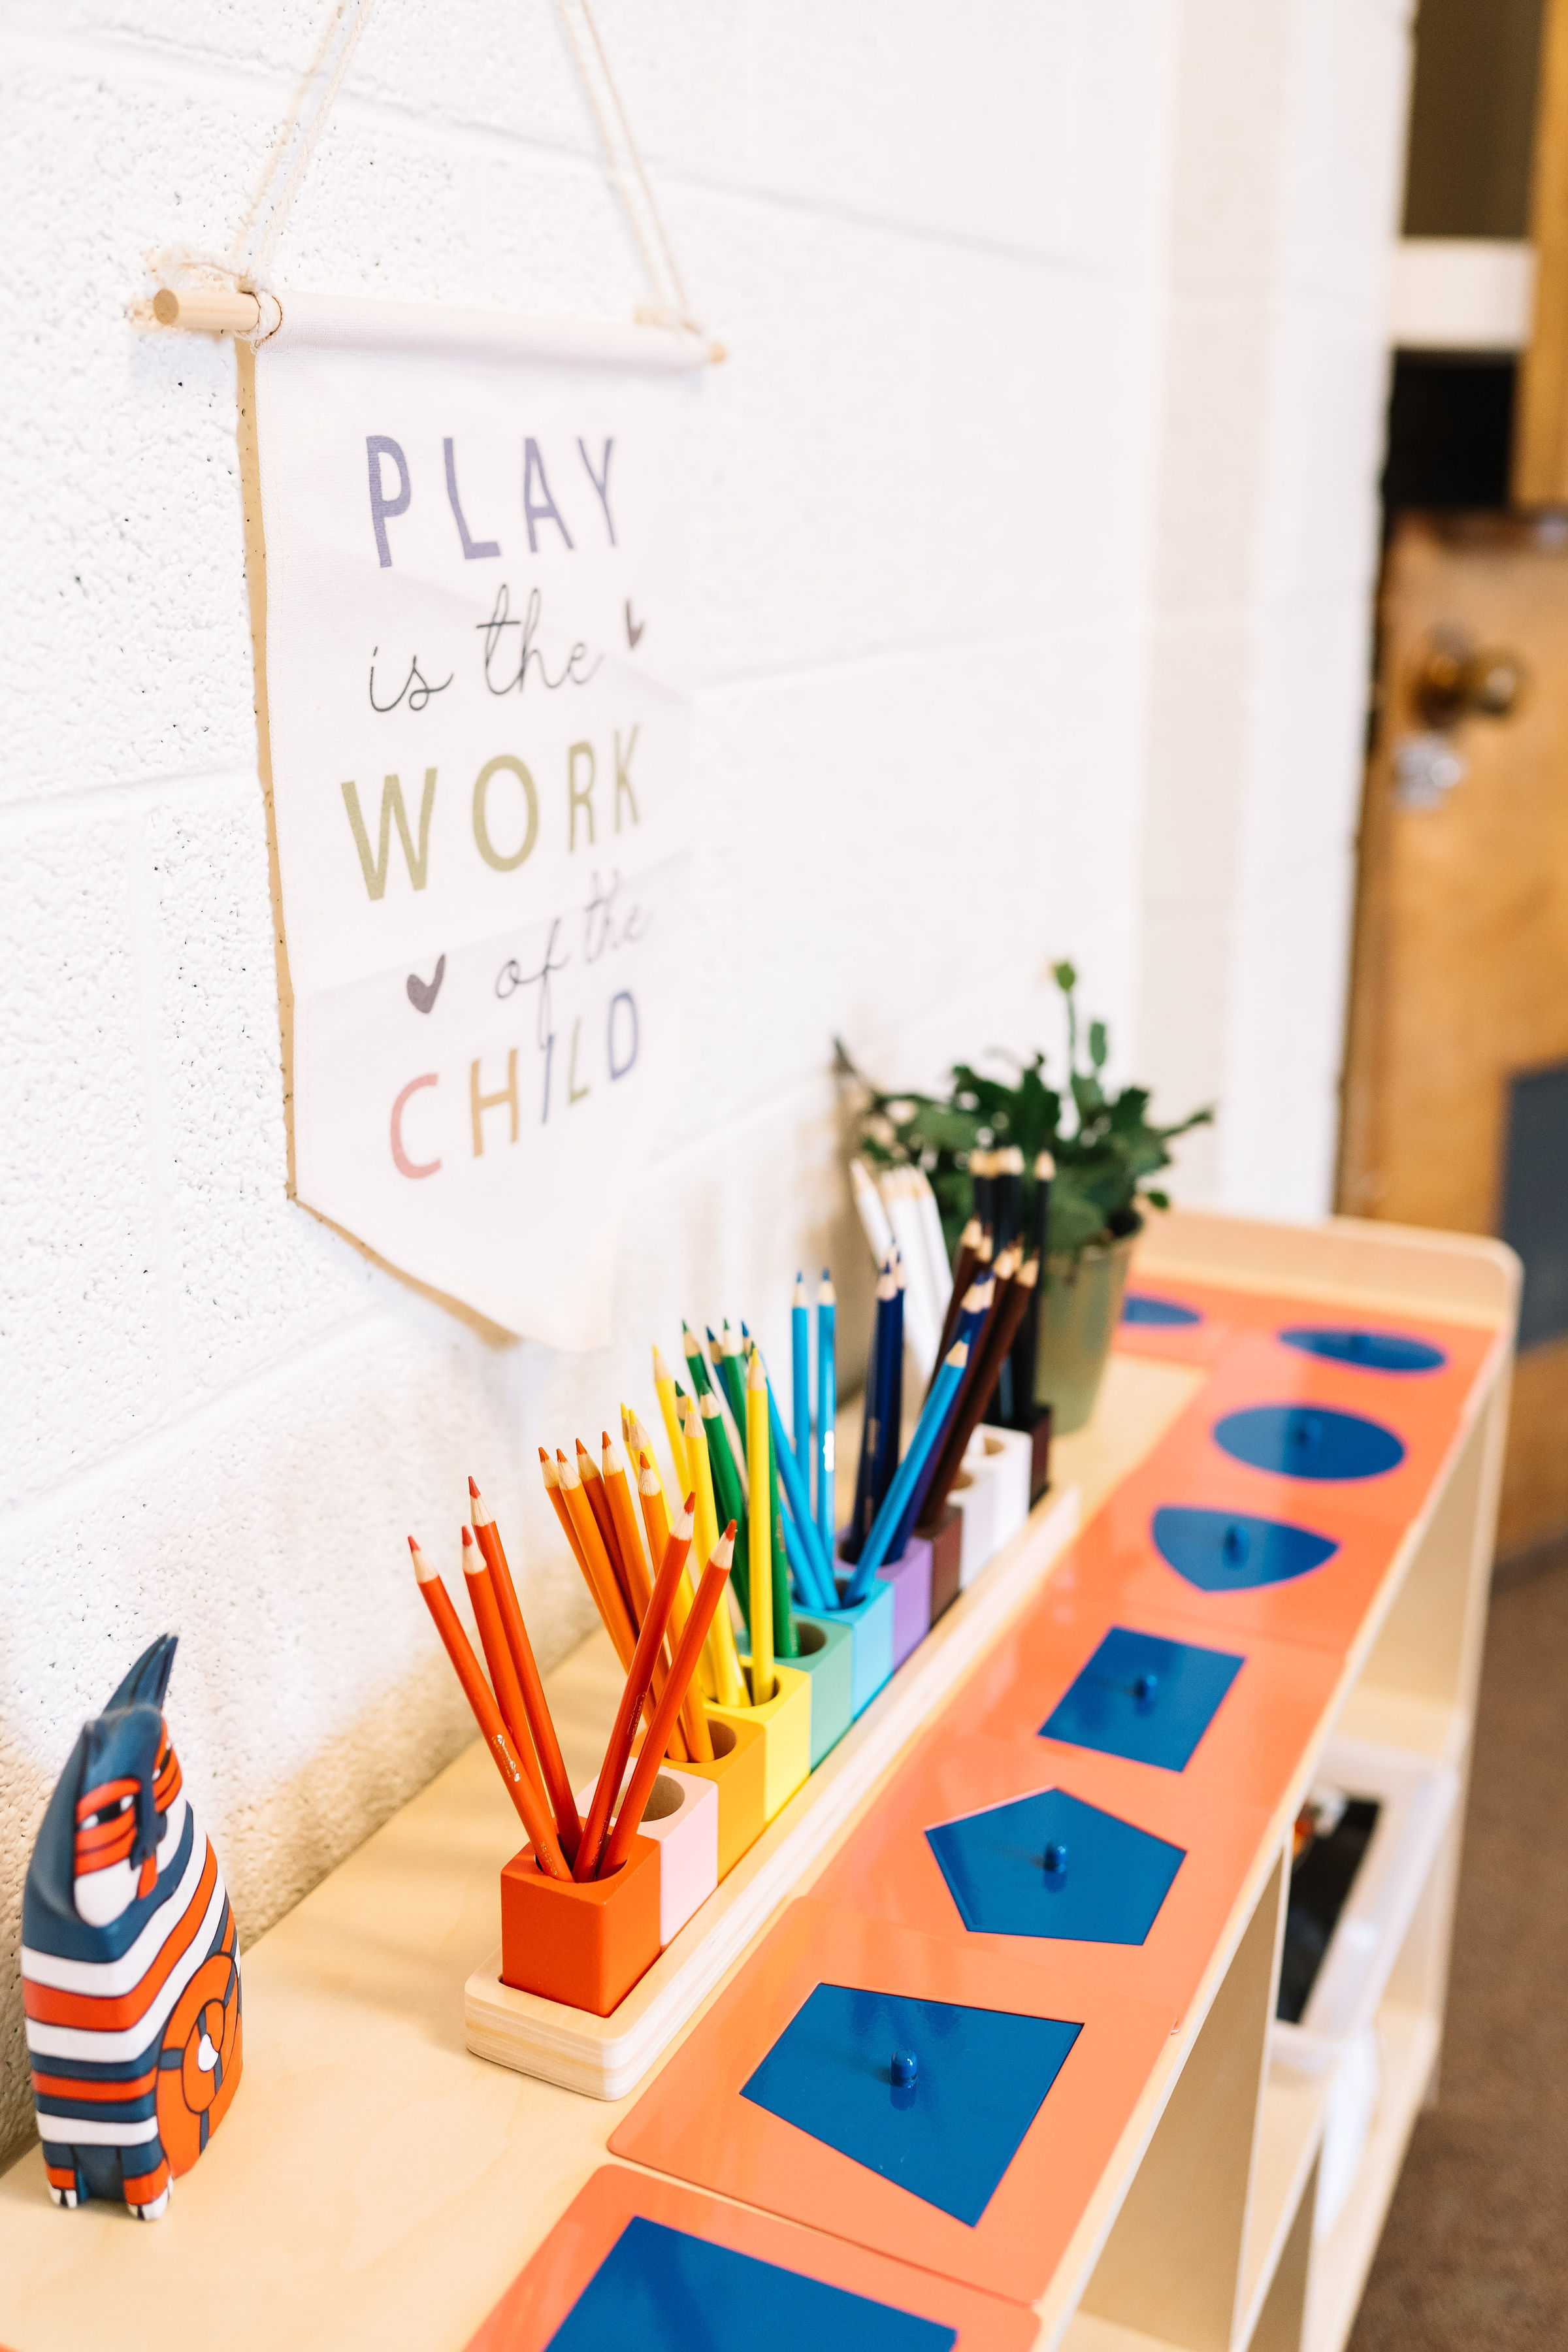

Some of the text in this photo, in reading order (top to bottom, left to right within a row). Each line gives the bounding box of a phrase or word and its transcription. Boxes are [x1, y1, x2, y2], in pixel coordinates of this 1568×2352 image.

[365, 434, 615, 568] PLAY
[370, 583, 604, 713] is the
[340, 724, 640, 902] WORK
[495, 869, 654, 1051] of the
[389, 989, 640, 1180] CHILD
